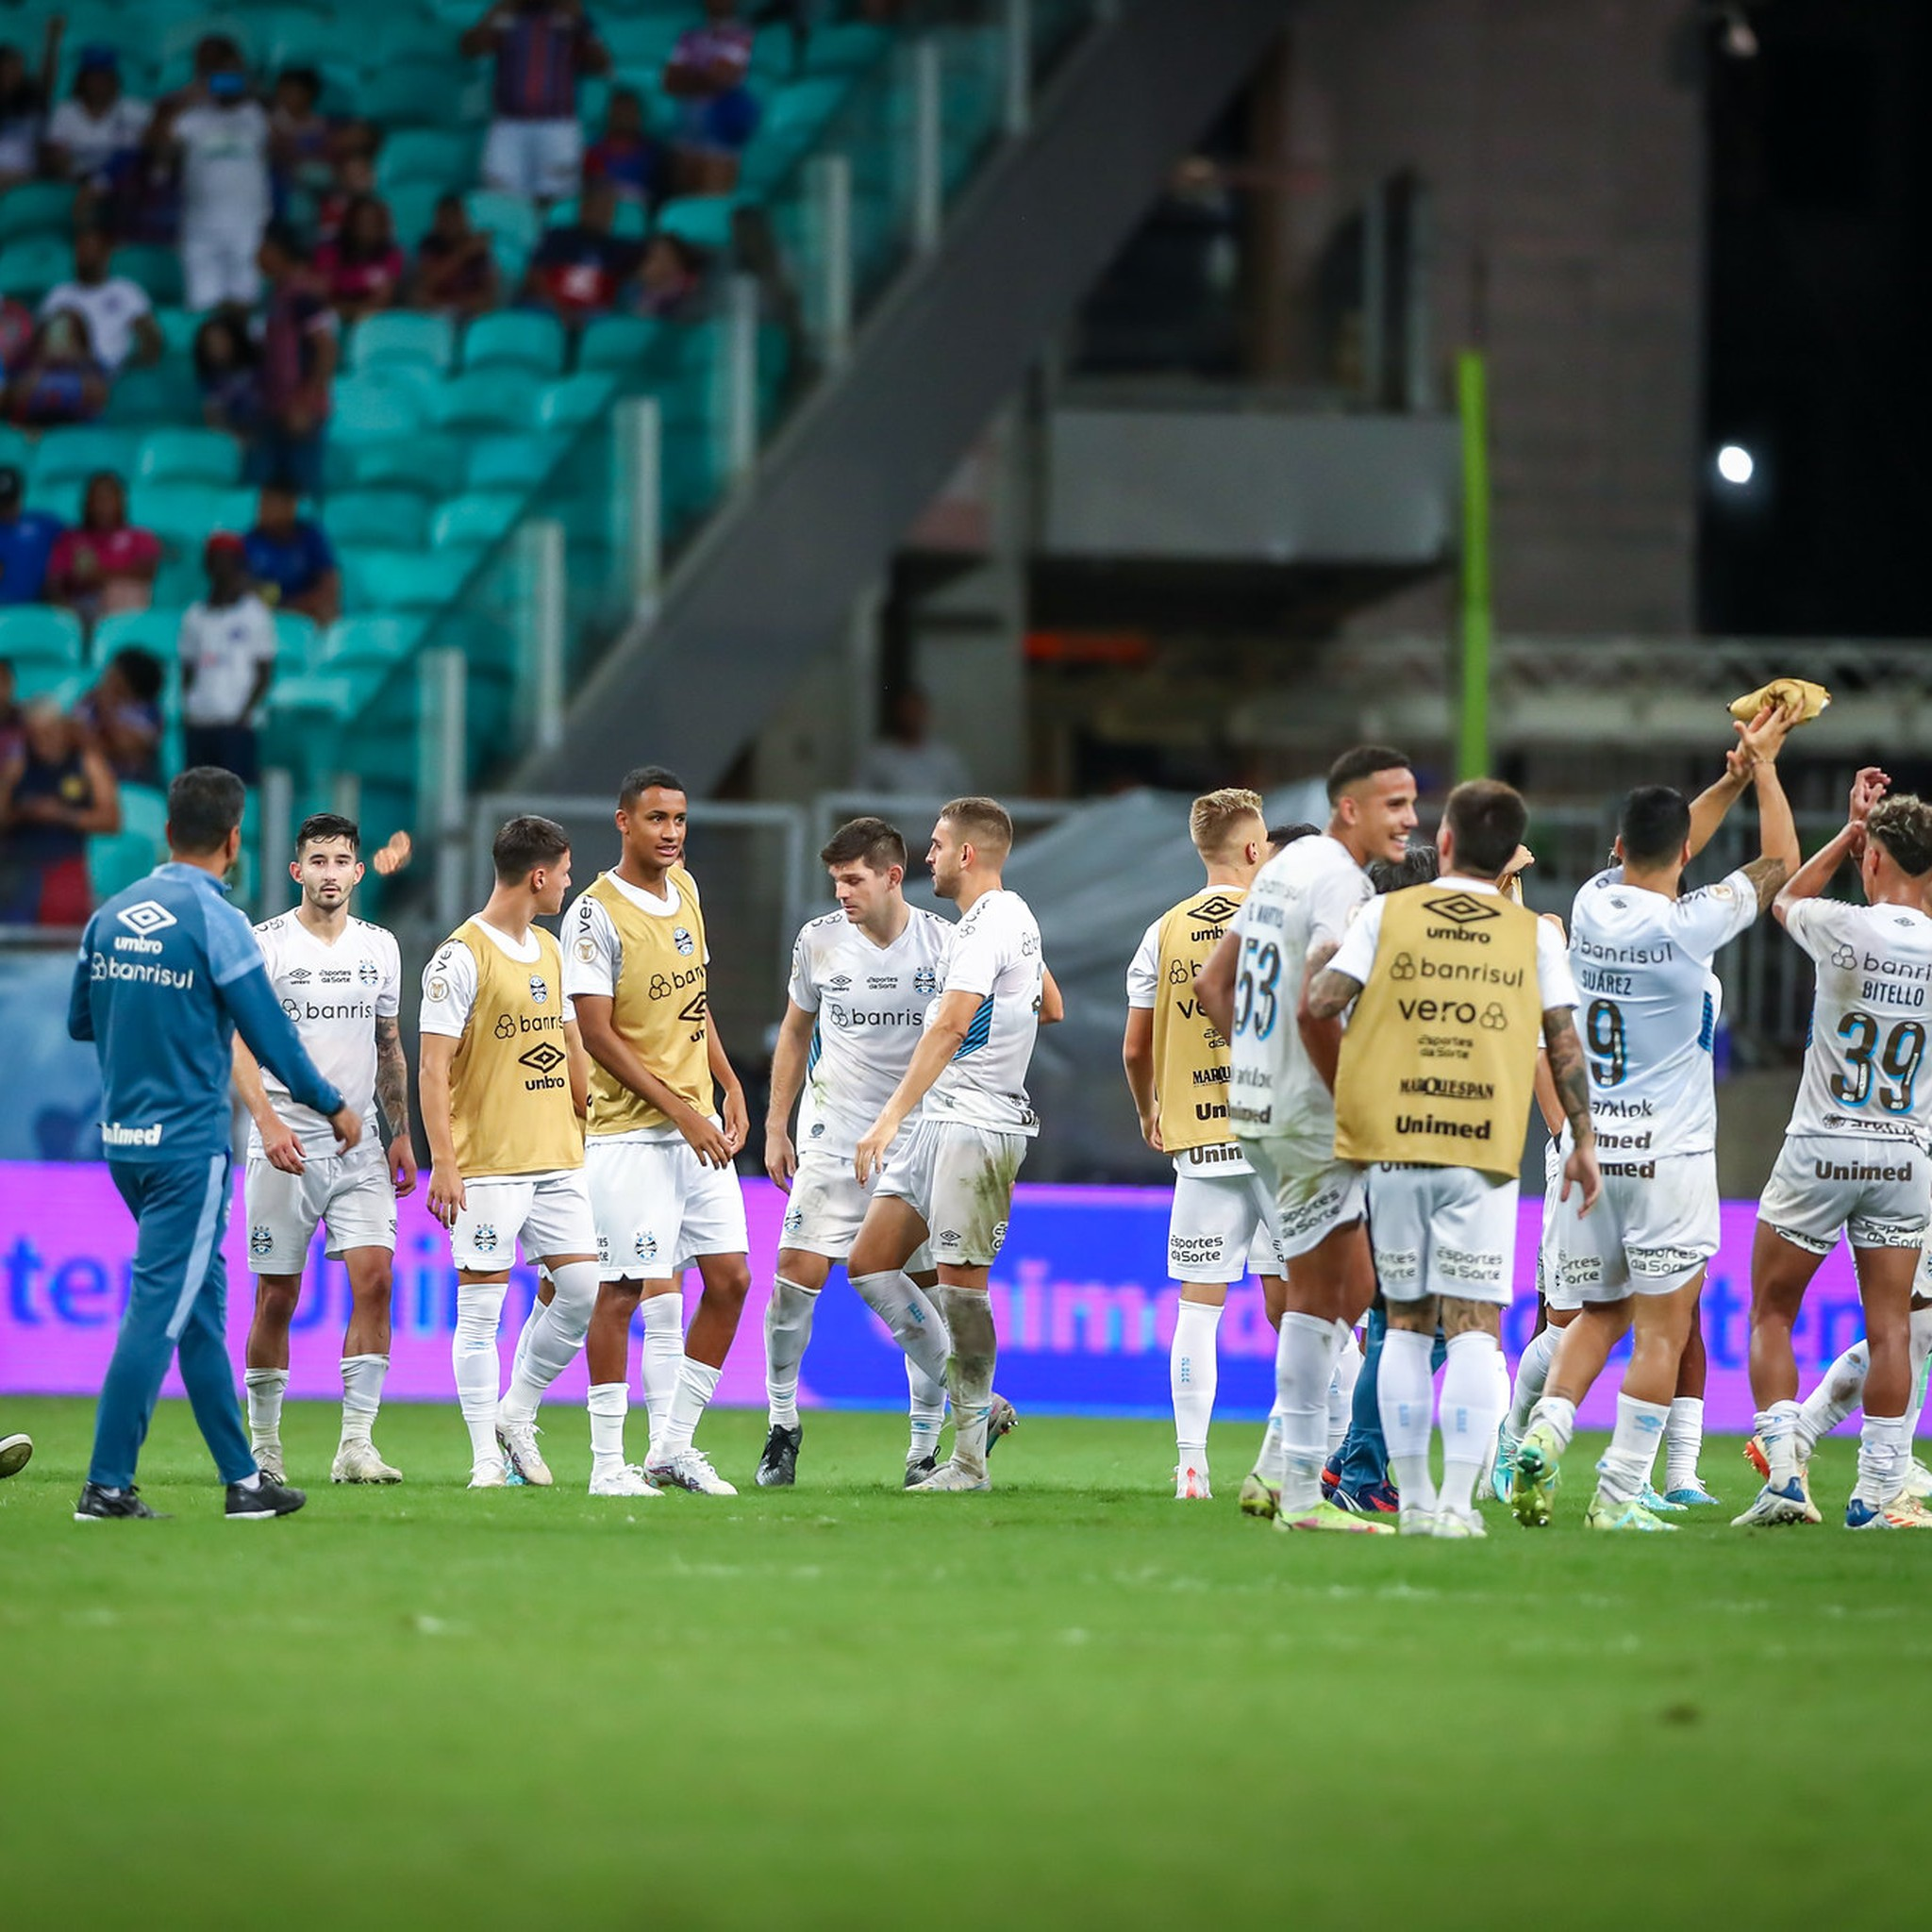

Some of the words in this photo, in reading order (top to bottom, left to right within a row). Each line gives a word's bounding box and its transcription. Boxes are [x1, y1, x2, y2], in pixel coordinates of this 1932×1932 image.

[114, 935, 163, 955] umbro
[1191, 925, 1226, 941] umb
[1427, 925, 1491, 943] umbro
[1581, 935, 1674, 963] banrisul
[108, 957, 194, 990] banrisul
[1421, 957, 1524, 988] banrisul
[1864, 952, 1932, 981] banri
[1234, 938, 1282, 1041] 53
[1581, 969, 1632, 995] SUÁREZ
[1862, 980, 1924, 1007] BITELLO
[307, 1001, 372, 1020] banris
[852, 1008, 923, 1025] banris
[1398, 998, 1476, 1024] vero
[1587, 999, 1627, 1089] 9
[1830, 1012, 1926, 1115] 39
[1395, 1114, 1491, 1140] Unimed
[1599, 1159, 1656, 1179] med
[1815, 1160, 1912, 1181] Unimed
